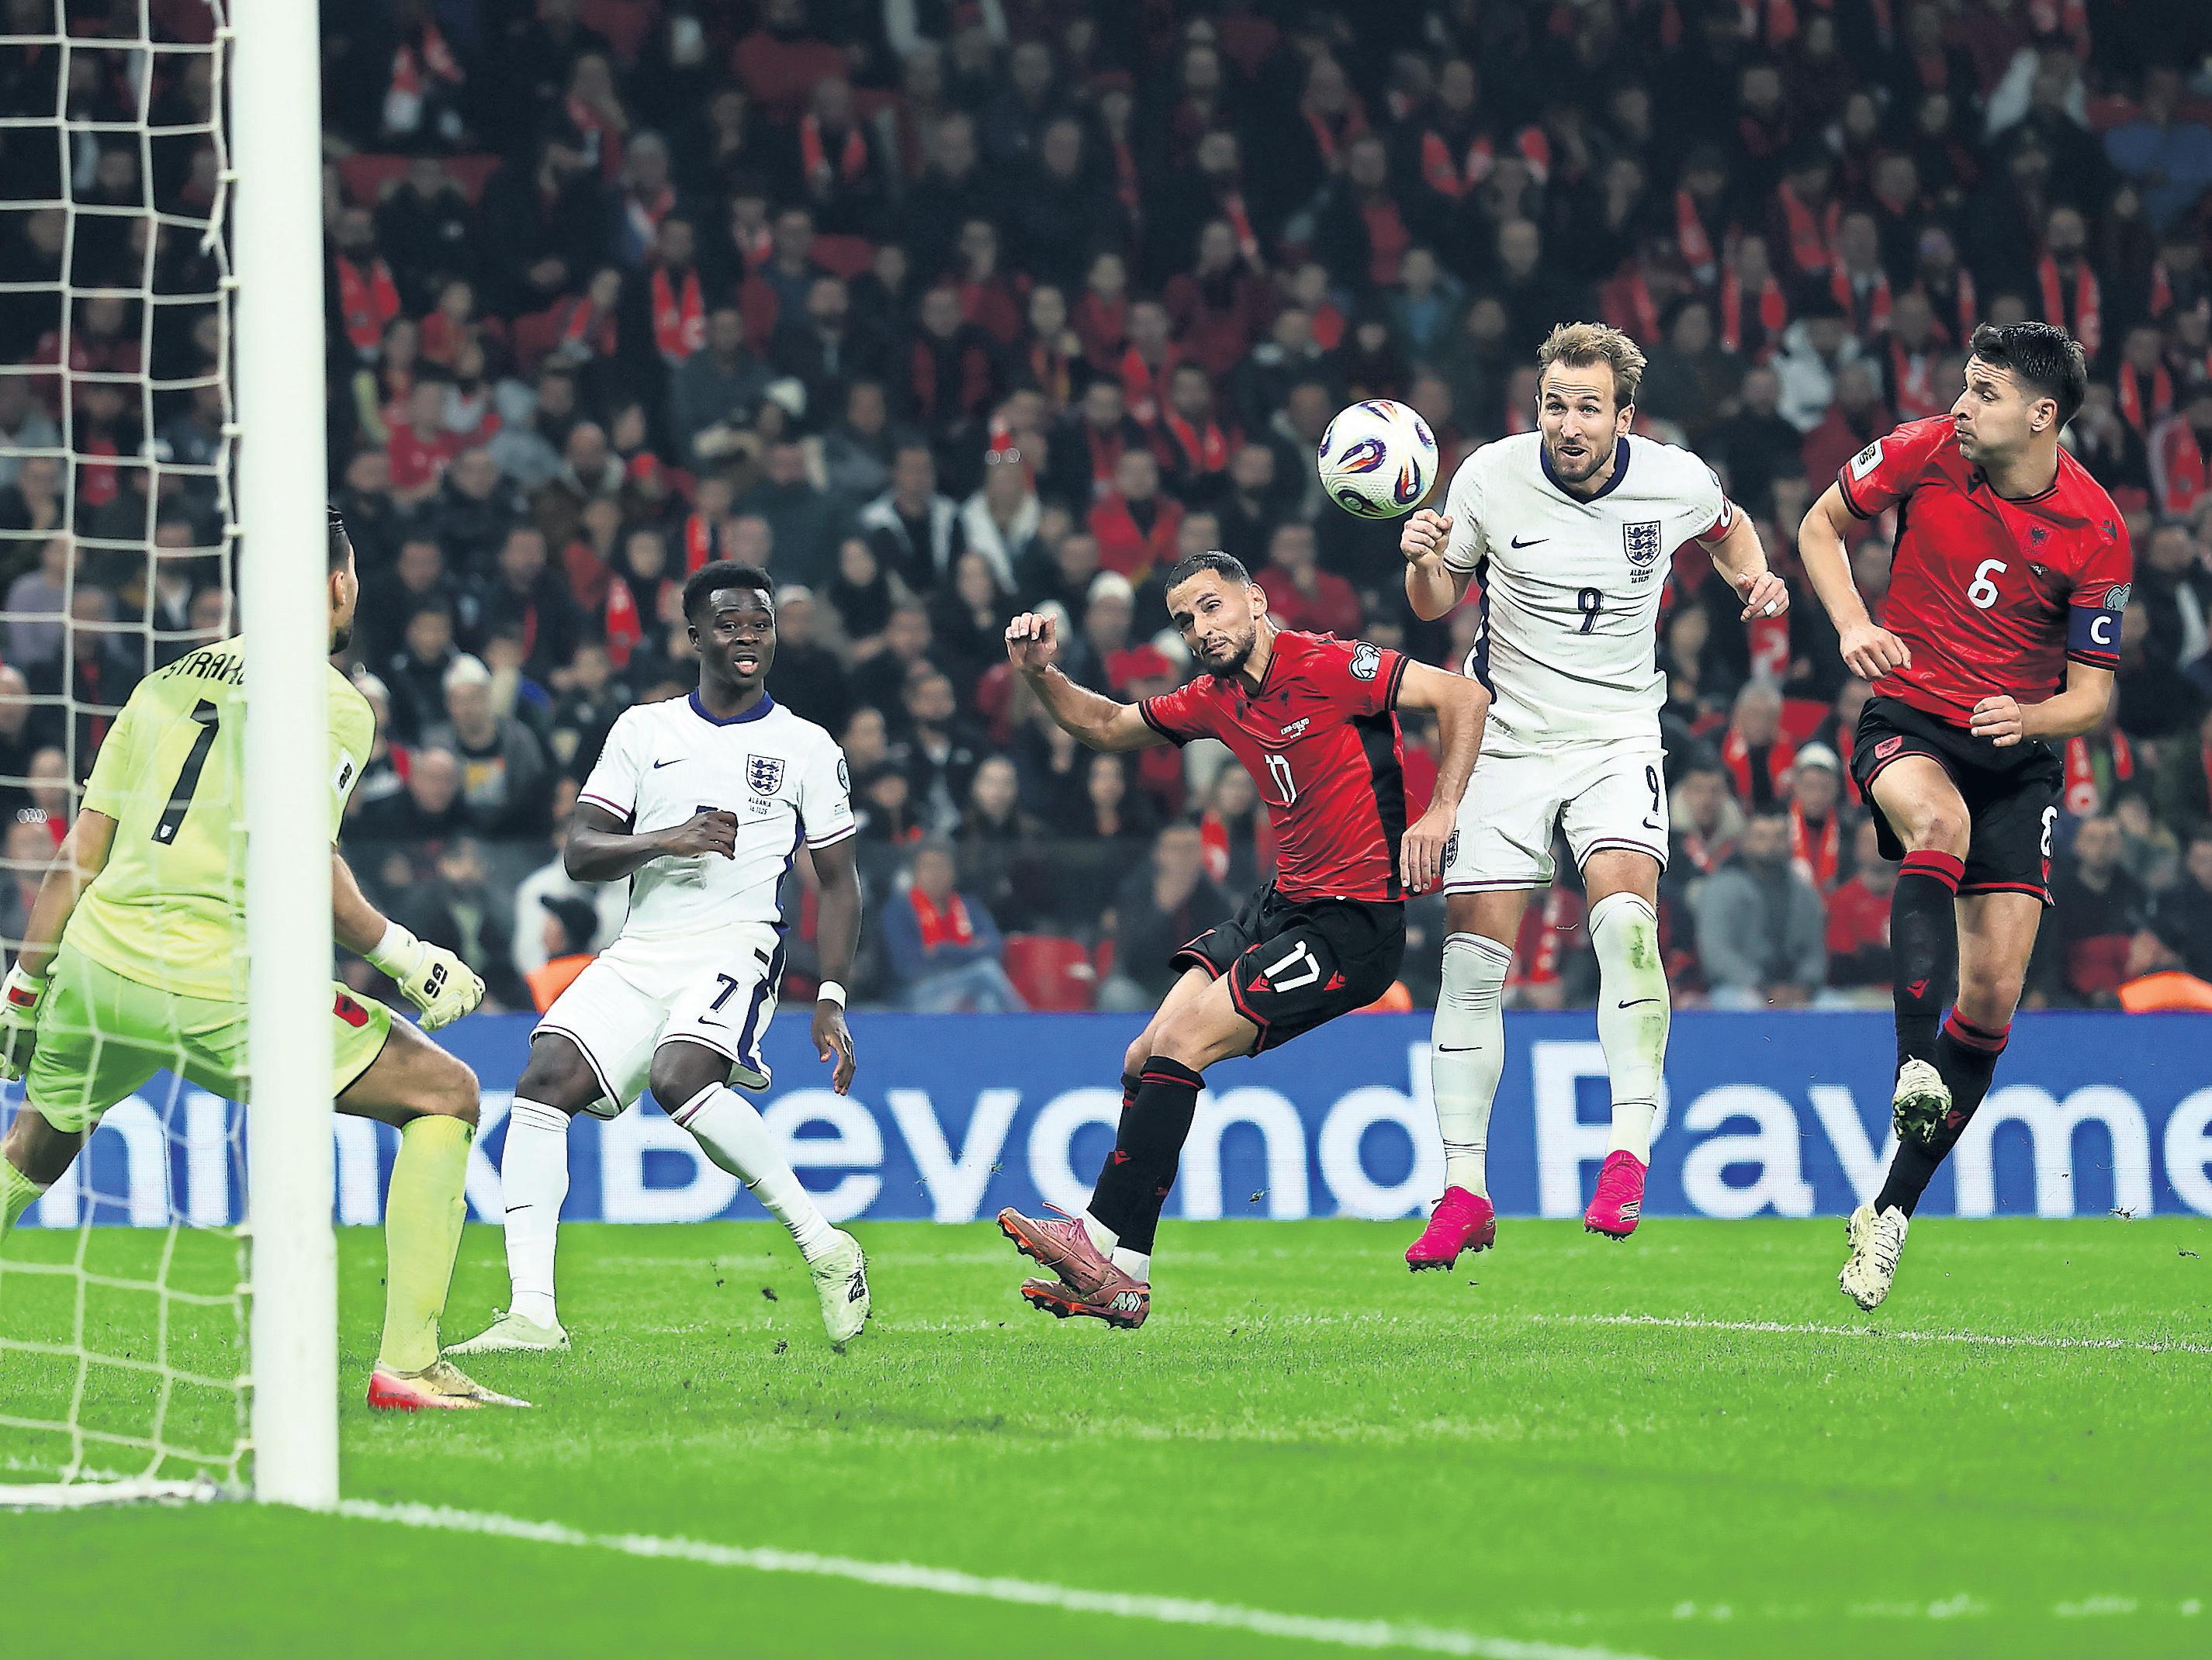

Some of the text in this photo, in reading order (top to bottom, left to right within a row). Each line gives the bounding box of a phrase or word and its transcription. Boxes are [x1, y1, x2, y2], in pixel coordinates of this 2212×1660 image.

[1967, 559, 2008, 609] 6
[1577, 587, 1604, 634] 9
[2090, 616, 2112, 645] C
[151, 698, 220, 846] 1
[1264, 754, 1298, 804] 17
[1646, 765, 1660, 815] 9
[1262, 939, 1321, 993] 17
[709, 973, 739, 1013] 7
